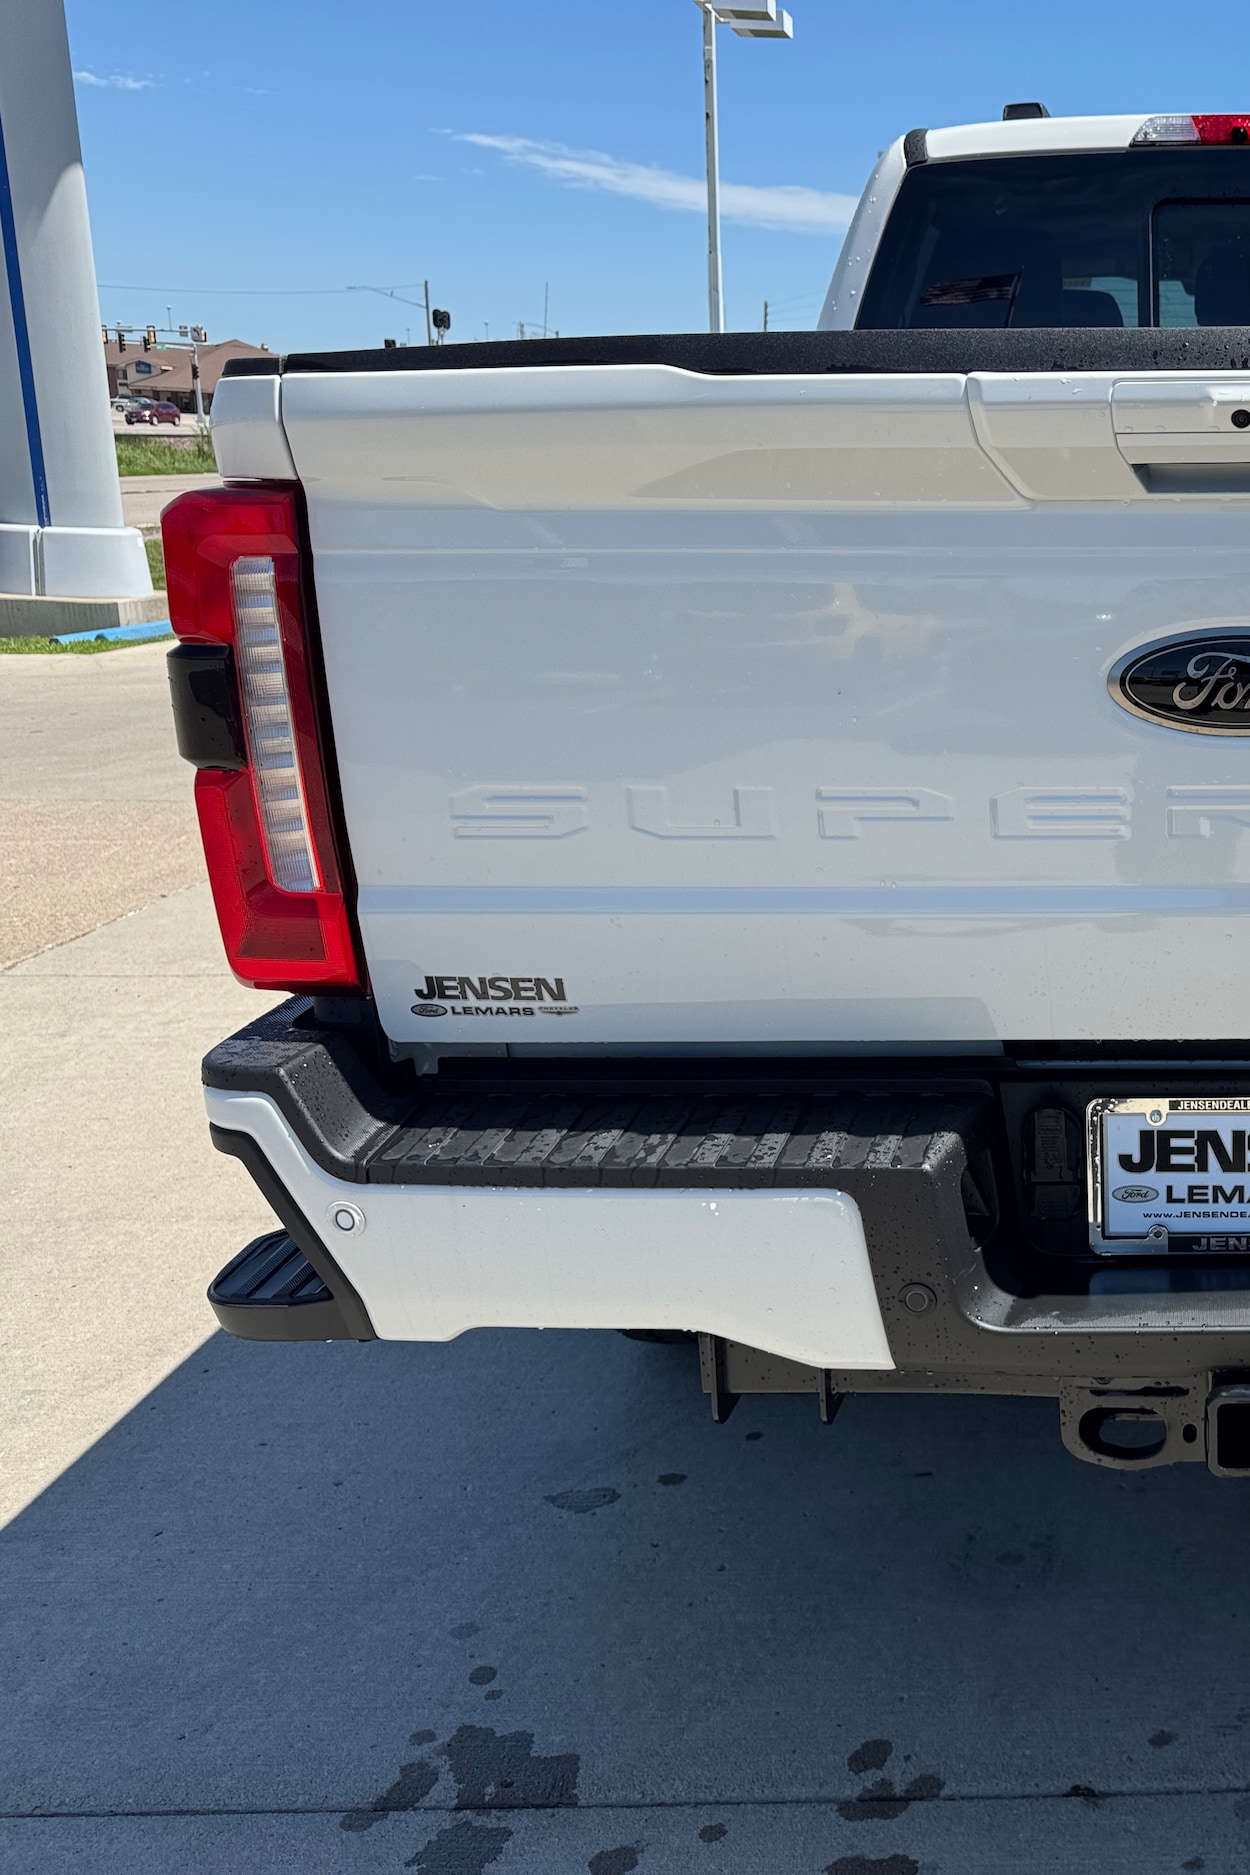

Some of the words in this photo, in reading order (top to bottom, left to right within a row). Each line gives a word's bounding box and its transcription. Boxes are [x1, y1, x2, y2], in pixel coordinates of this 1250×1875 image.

[414, 976, 567, 1001] JENSEN
[451, 1006, 535, 1016] LEMARS
[1121, 1189, 1149, 1200] Ford
